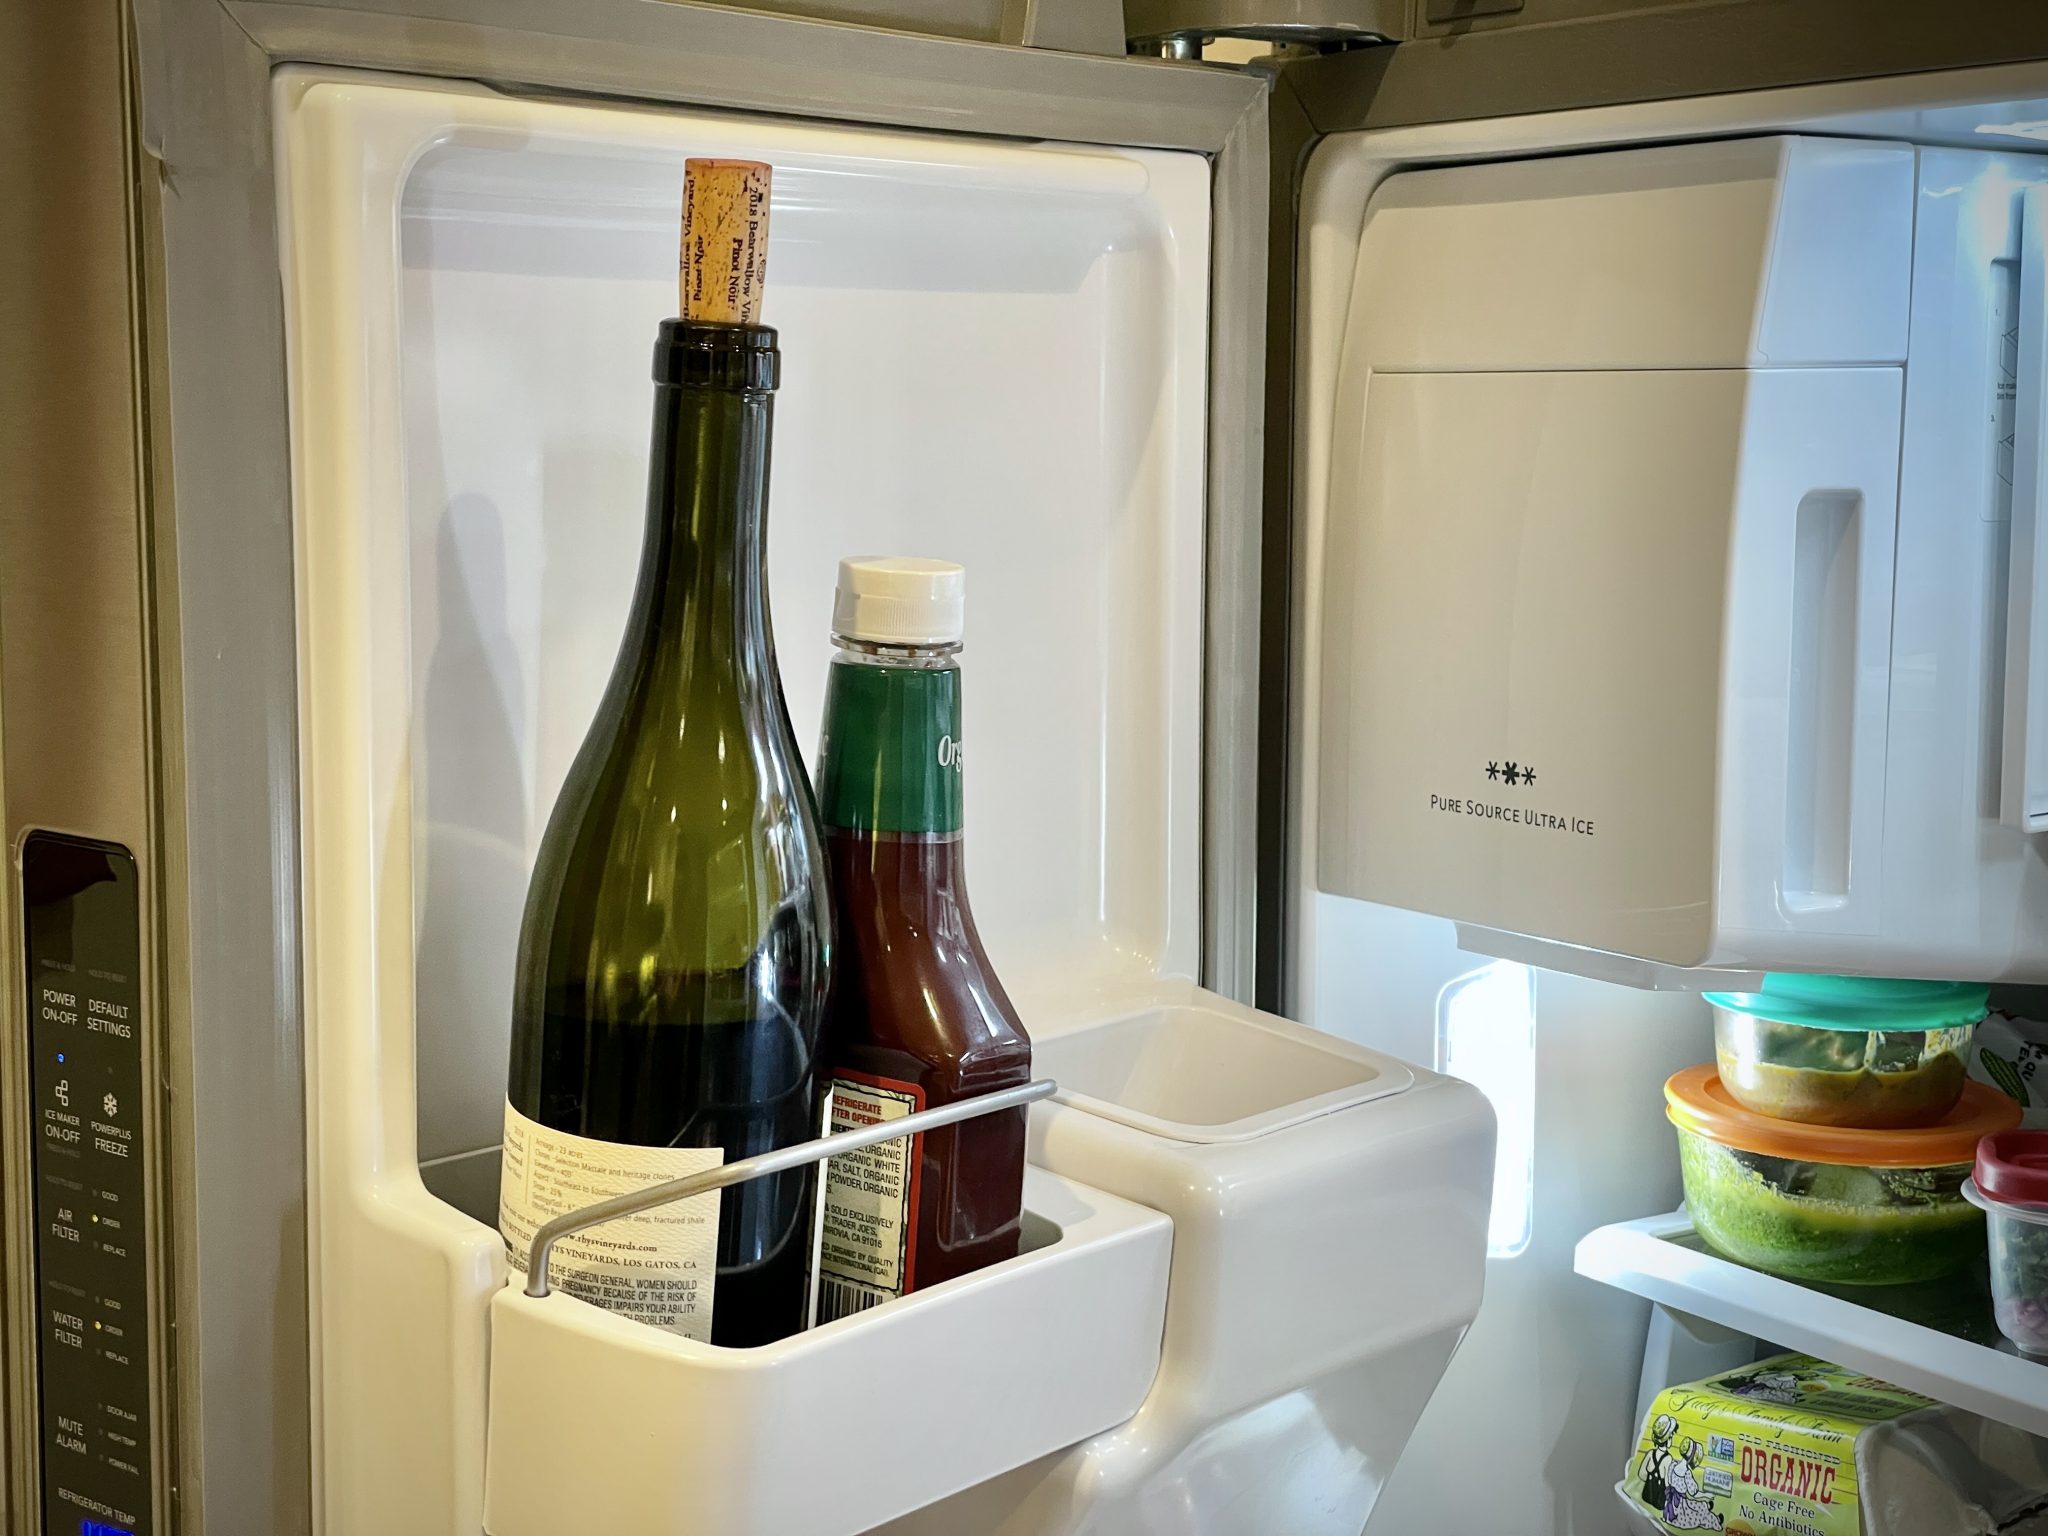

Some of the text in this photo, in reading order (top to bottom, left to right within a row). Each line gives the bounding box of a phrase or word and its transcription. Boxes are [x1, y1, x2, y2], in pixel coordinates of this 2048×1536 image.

[749, 187, 758, 216] 2018
[731, 237, 743, 273] Pinot
[743, 221, 759, 298] Bearwallow
[43, 989, 76, 1007] POWER
[42, 1007, 78, 1026] ON-OFF
[88, 999, 128, 1019] DEFAULT
[87, 1017, 131, 1038] SETTINGS
[832, 1106, 850, 1120] FTER
[833, 1094, 882, 1115] REFRIGERATE
[45, 1109, 80, 1127] ICE MAKER
[45, 1124, 81, 1144] ON-OFF
[91, 1121, 132, 1141] POWERPLUS
[95, 1137, 129, 1157] FREEZE
[864, 1144, 901, 1161] ORGANIC
[622, 1170, 651, 1180] heritage
[874, 1158, 900, 1174] WHITE
[863, 1168, 900, 1186] ORGANIC
[863, 1181, 899, 1199] ORGANIC
[58, 1208, 73, 1222] AIR
[831, 1204, 848, 1217] SOLD
[849, 1210, 894, 1229] EXCLUSIVELY
[831, 1215, 857, 1231] TRADER
[52, 1223, 80, 1243] FILTER
[851, 1232, 861, 1243] CA
[861, 1236, 883, 1249] 91016
[623, 1258, 642, 1267] LOS
[683, 1260, 697, 1269] CA
[857, 1252, 866, 1261] BY
[867, 1255, 894, 1268] QUALITY
[555, 1264, 566, 1277] THE
[567, 1267, 600, 1284] SURGEON
[636, 1279, 666, 1290] WOMEN
[666, 1279, 698, 1291] SHOULD
[562, 1279, 603, 1296] PREGNANCY
[603, 1287, 636, 1301] BECAUSE
[638, 1289, 648, 1300] OF
[650, 1290, 665, 1302] THE
[667, 1291, 685, 1302] RISK
[686, 1292, 697, 1302] OF
[613, 1300, 645, 1313] IMPAIRS
[645, 1302, 667, 1314] YOUR
[667, 1303, 697, 1315] ABILITY
[53, 1309, 83, 1332] WATER
[55, 1328, 83, 1350] FILTER
[58, 1415, 84, 1436] MUTE
[56, 1433, 87, 1455] ALARM
[1738, 1433, 1841, 1465] OLD FASHIONED
[1740, 1445, 1836, 1505] ORGANIC
[58, 1487, 136, 1526] REFRIGERATOR TEMP
[1753, 1491, 1816, 1519] Cage Free
[1739, 1505, 1826, 1536] No Antibiotics
